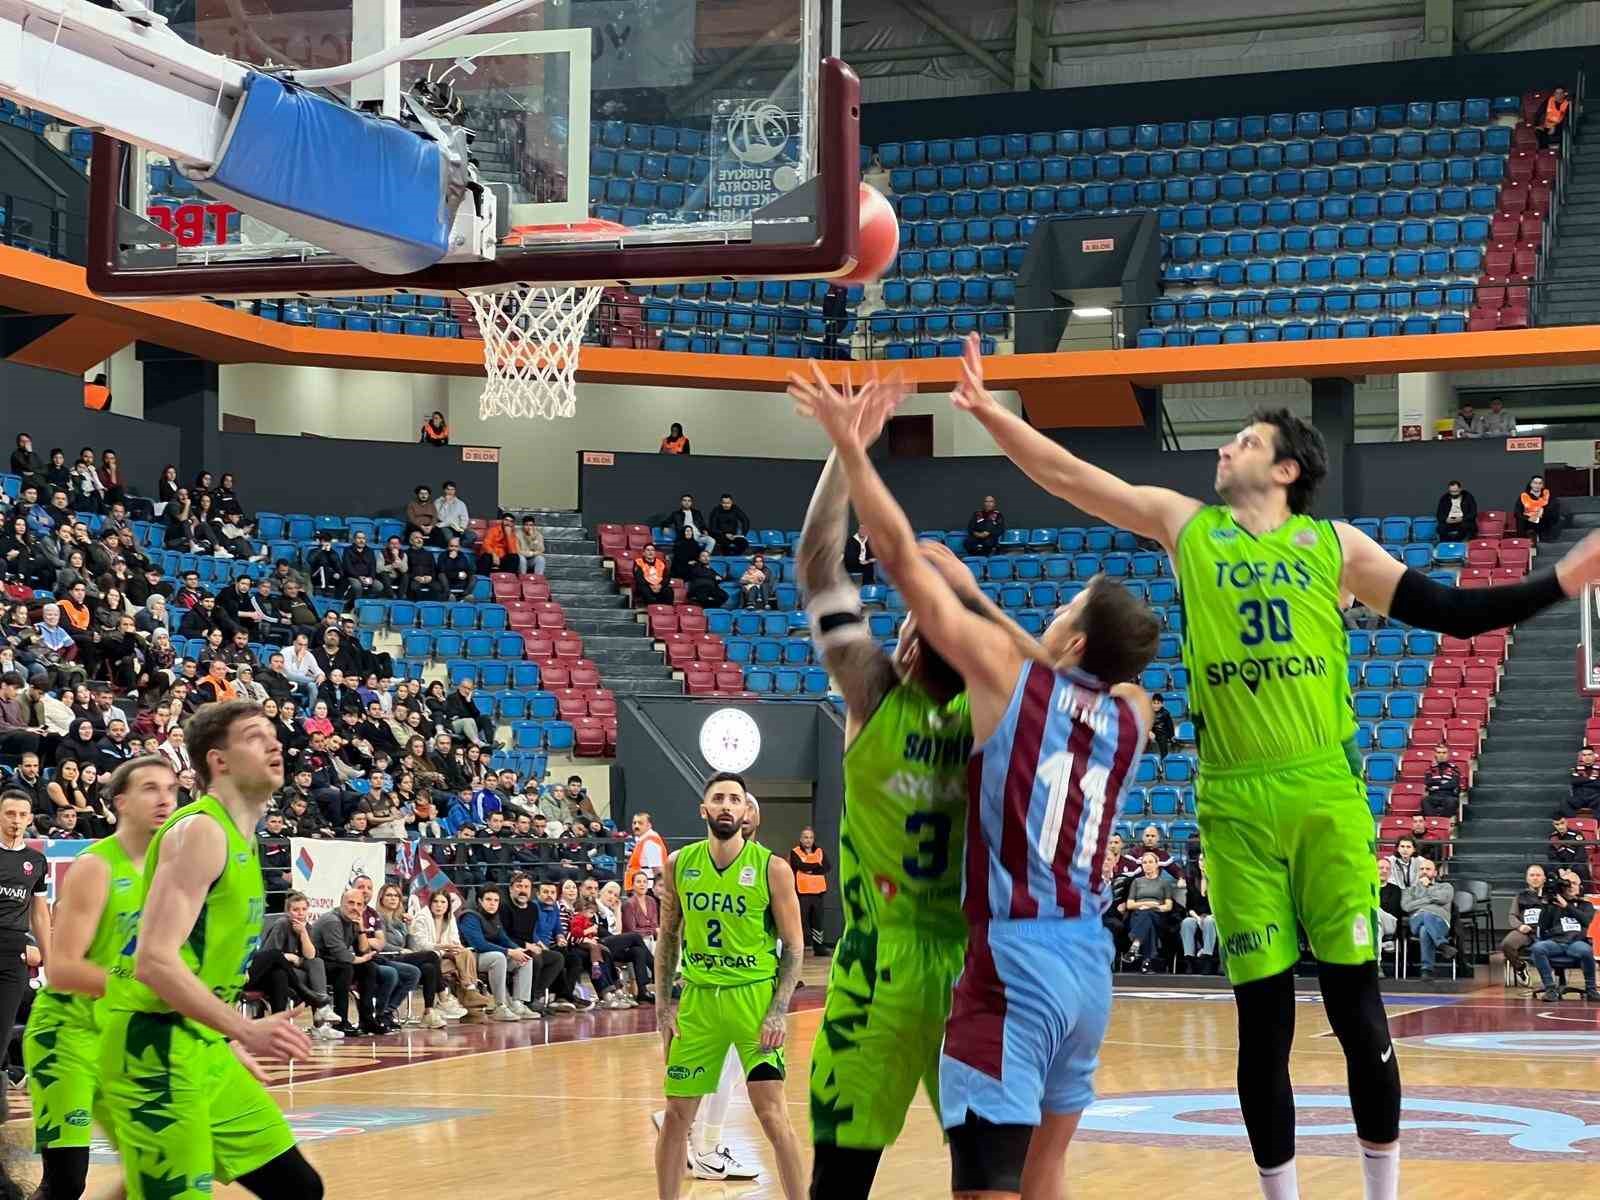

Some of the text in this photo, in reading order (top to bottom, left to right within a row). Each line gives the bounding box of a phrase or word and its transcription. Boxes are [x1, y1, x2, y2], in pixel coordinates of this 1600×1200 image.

[1215, 559, 1313, 591] TOFAŞ
[1239, 599, 1294, 646] 30
[1037, 751, 1111, 869] 11
[902, 811, 952, 879] 3
[685, 891, 746, 917] TOFAŞ
[706, 918, 723, 948] 2
